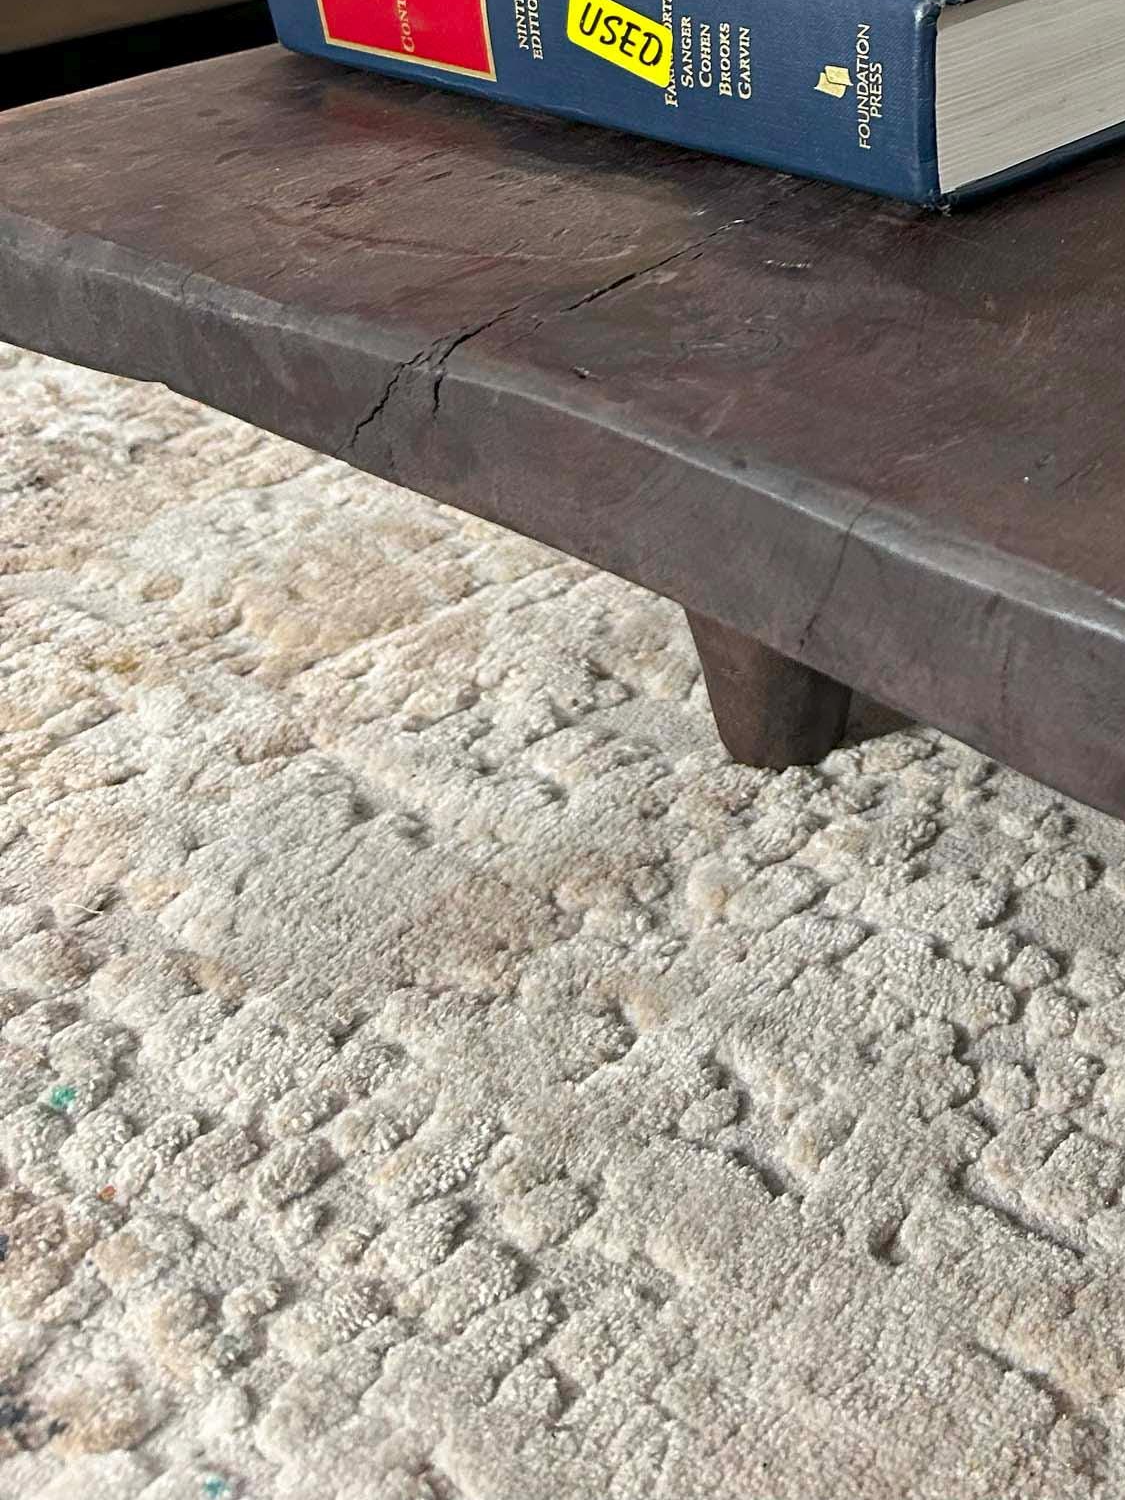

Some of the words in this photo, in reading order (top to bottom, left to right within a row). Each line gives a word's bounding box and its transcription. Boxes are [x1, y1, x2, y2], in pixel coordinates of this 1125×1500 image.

[578, 1, 664, 67] USED
[680, 15, 694, 89] SANGER
[698, 23, 713, 88] COHEN
[718, 22, 733, 97] BROOKS
[738, 26, 752, 100] GARVIN
[855, 23, 873, 150] FOUNDATION
[869, 62, 883, 119] PRESS
